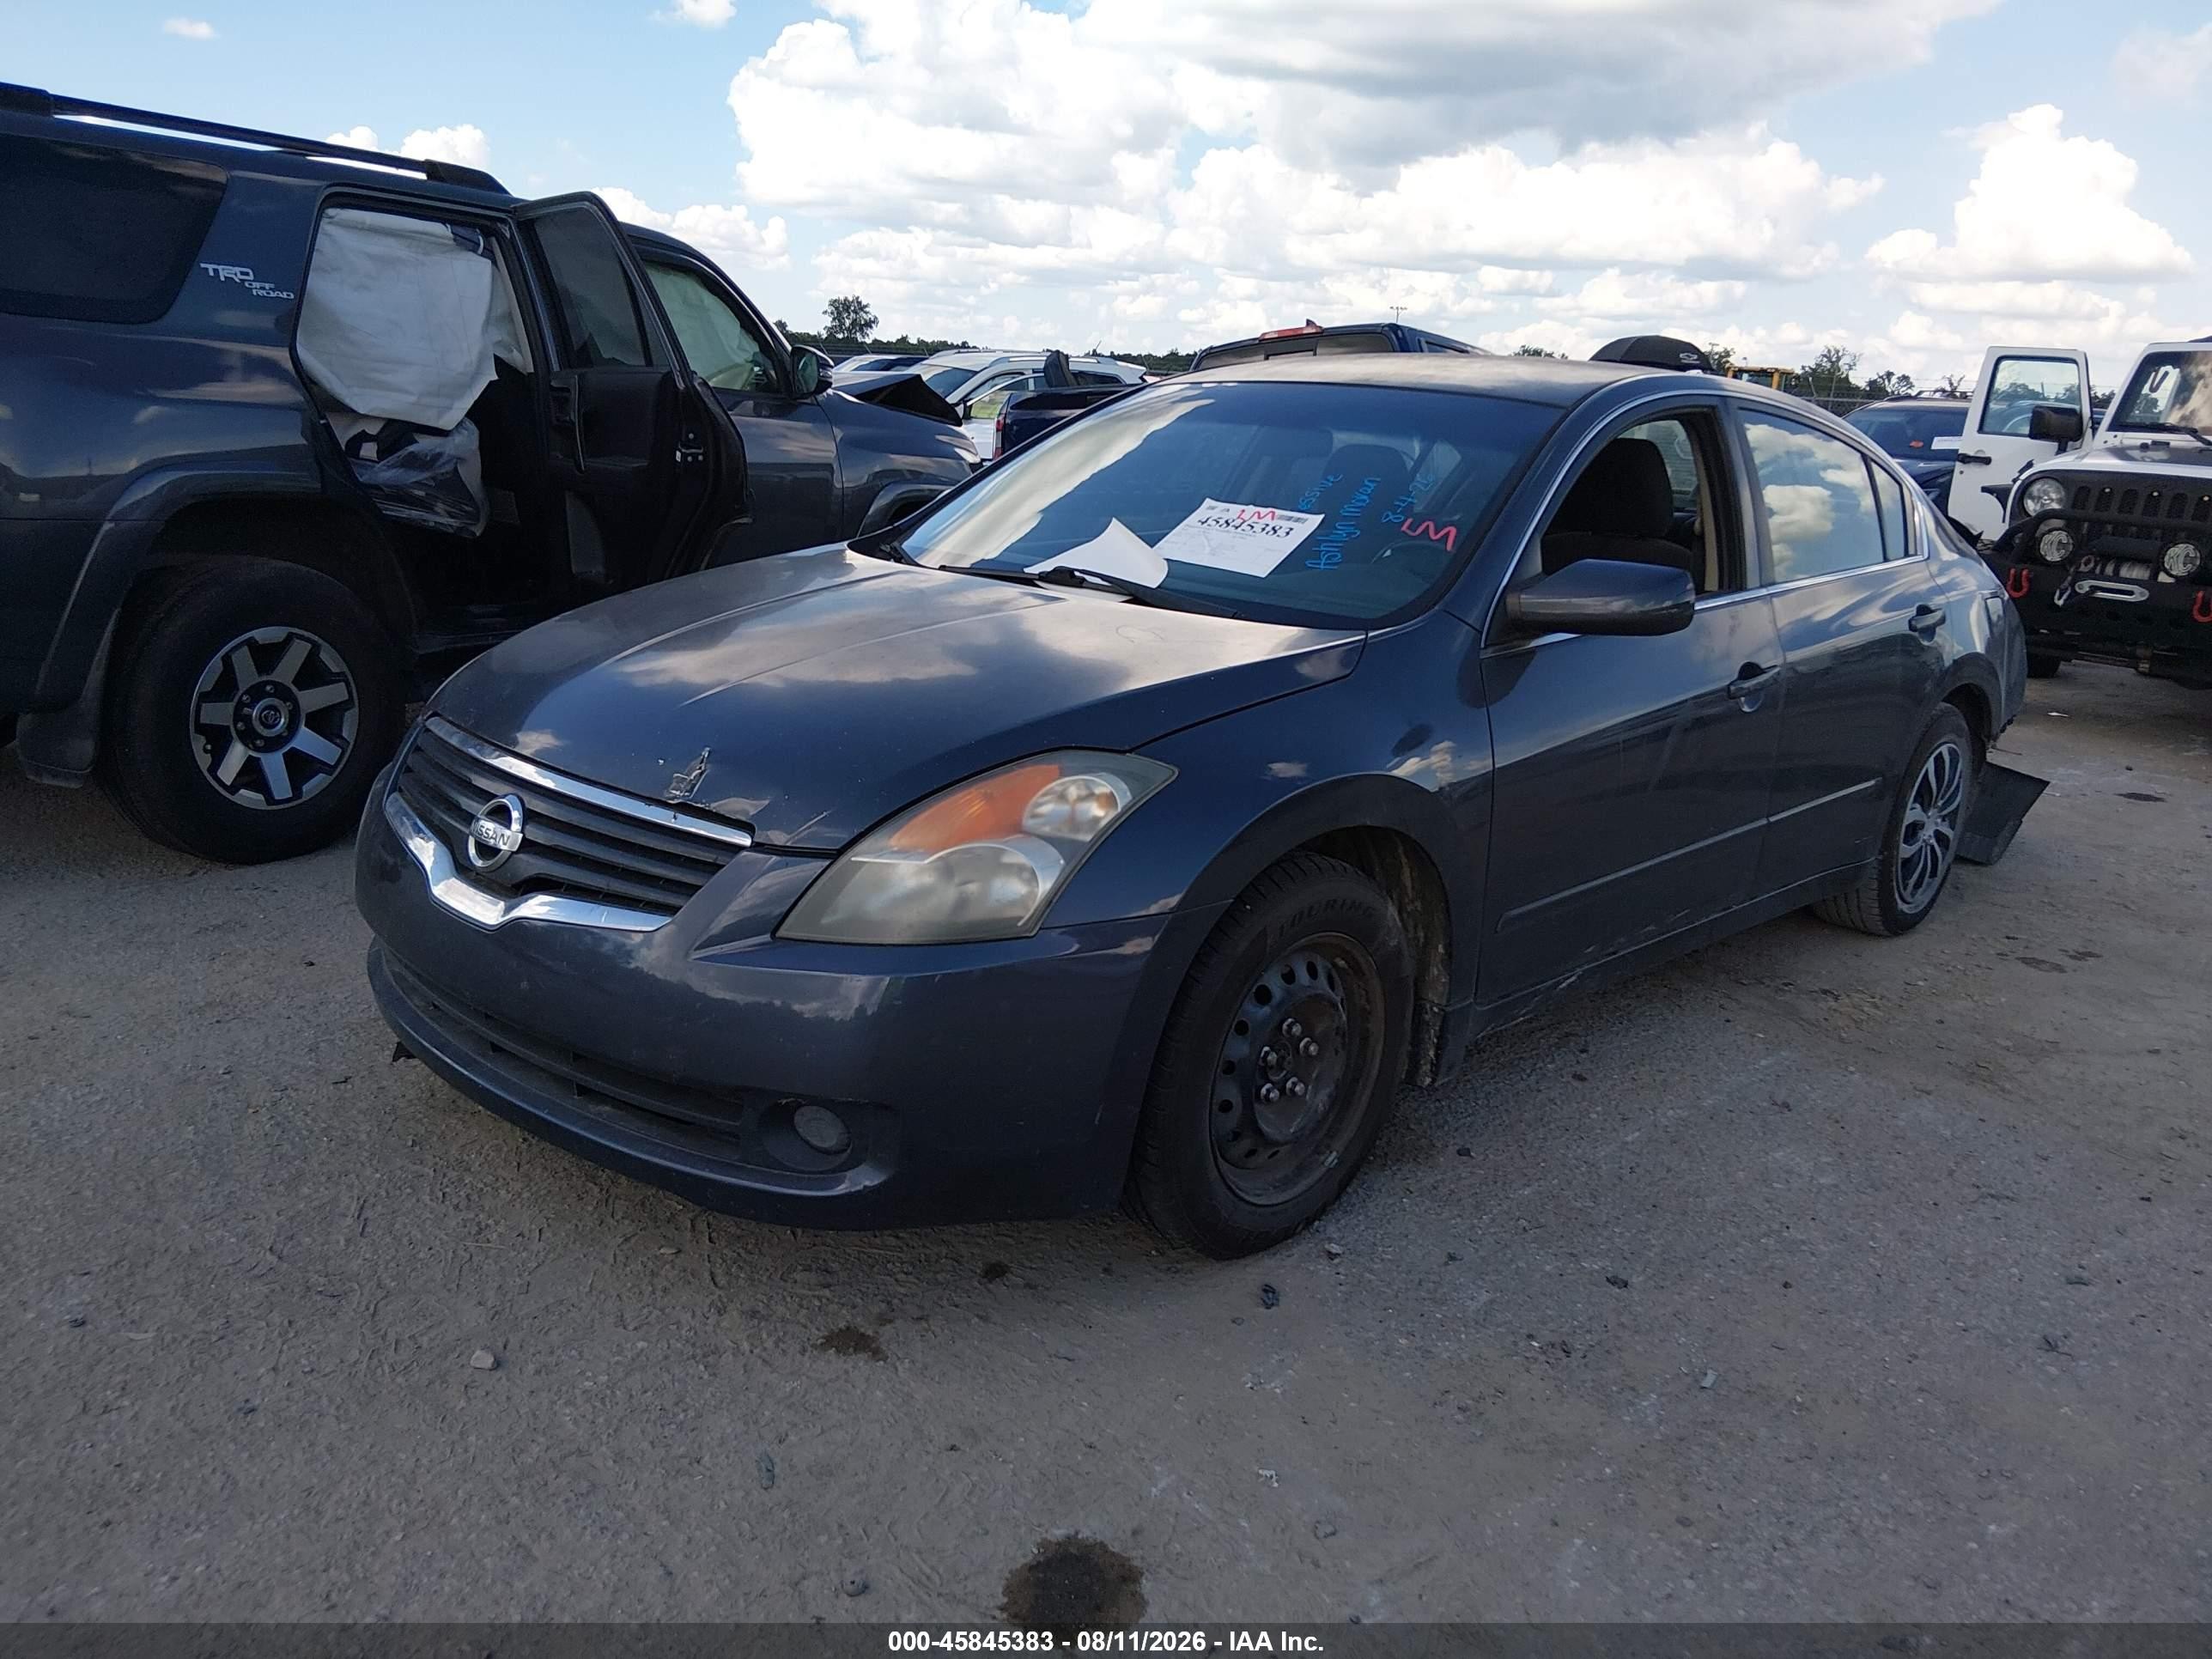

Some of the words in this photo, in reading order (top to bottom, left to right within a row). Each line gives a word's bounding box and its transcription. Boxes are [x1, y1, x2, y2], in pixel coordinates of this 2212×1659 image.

[198, 262, 254, 283] TRD
[244, 281, 276, 290] OFF
[252, 289, 295, 300] ROAD
[1197, 514, 1295, 538] 45845383
